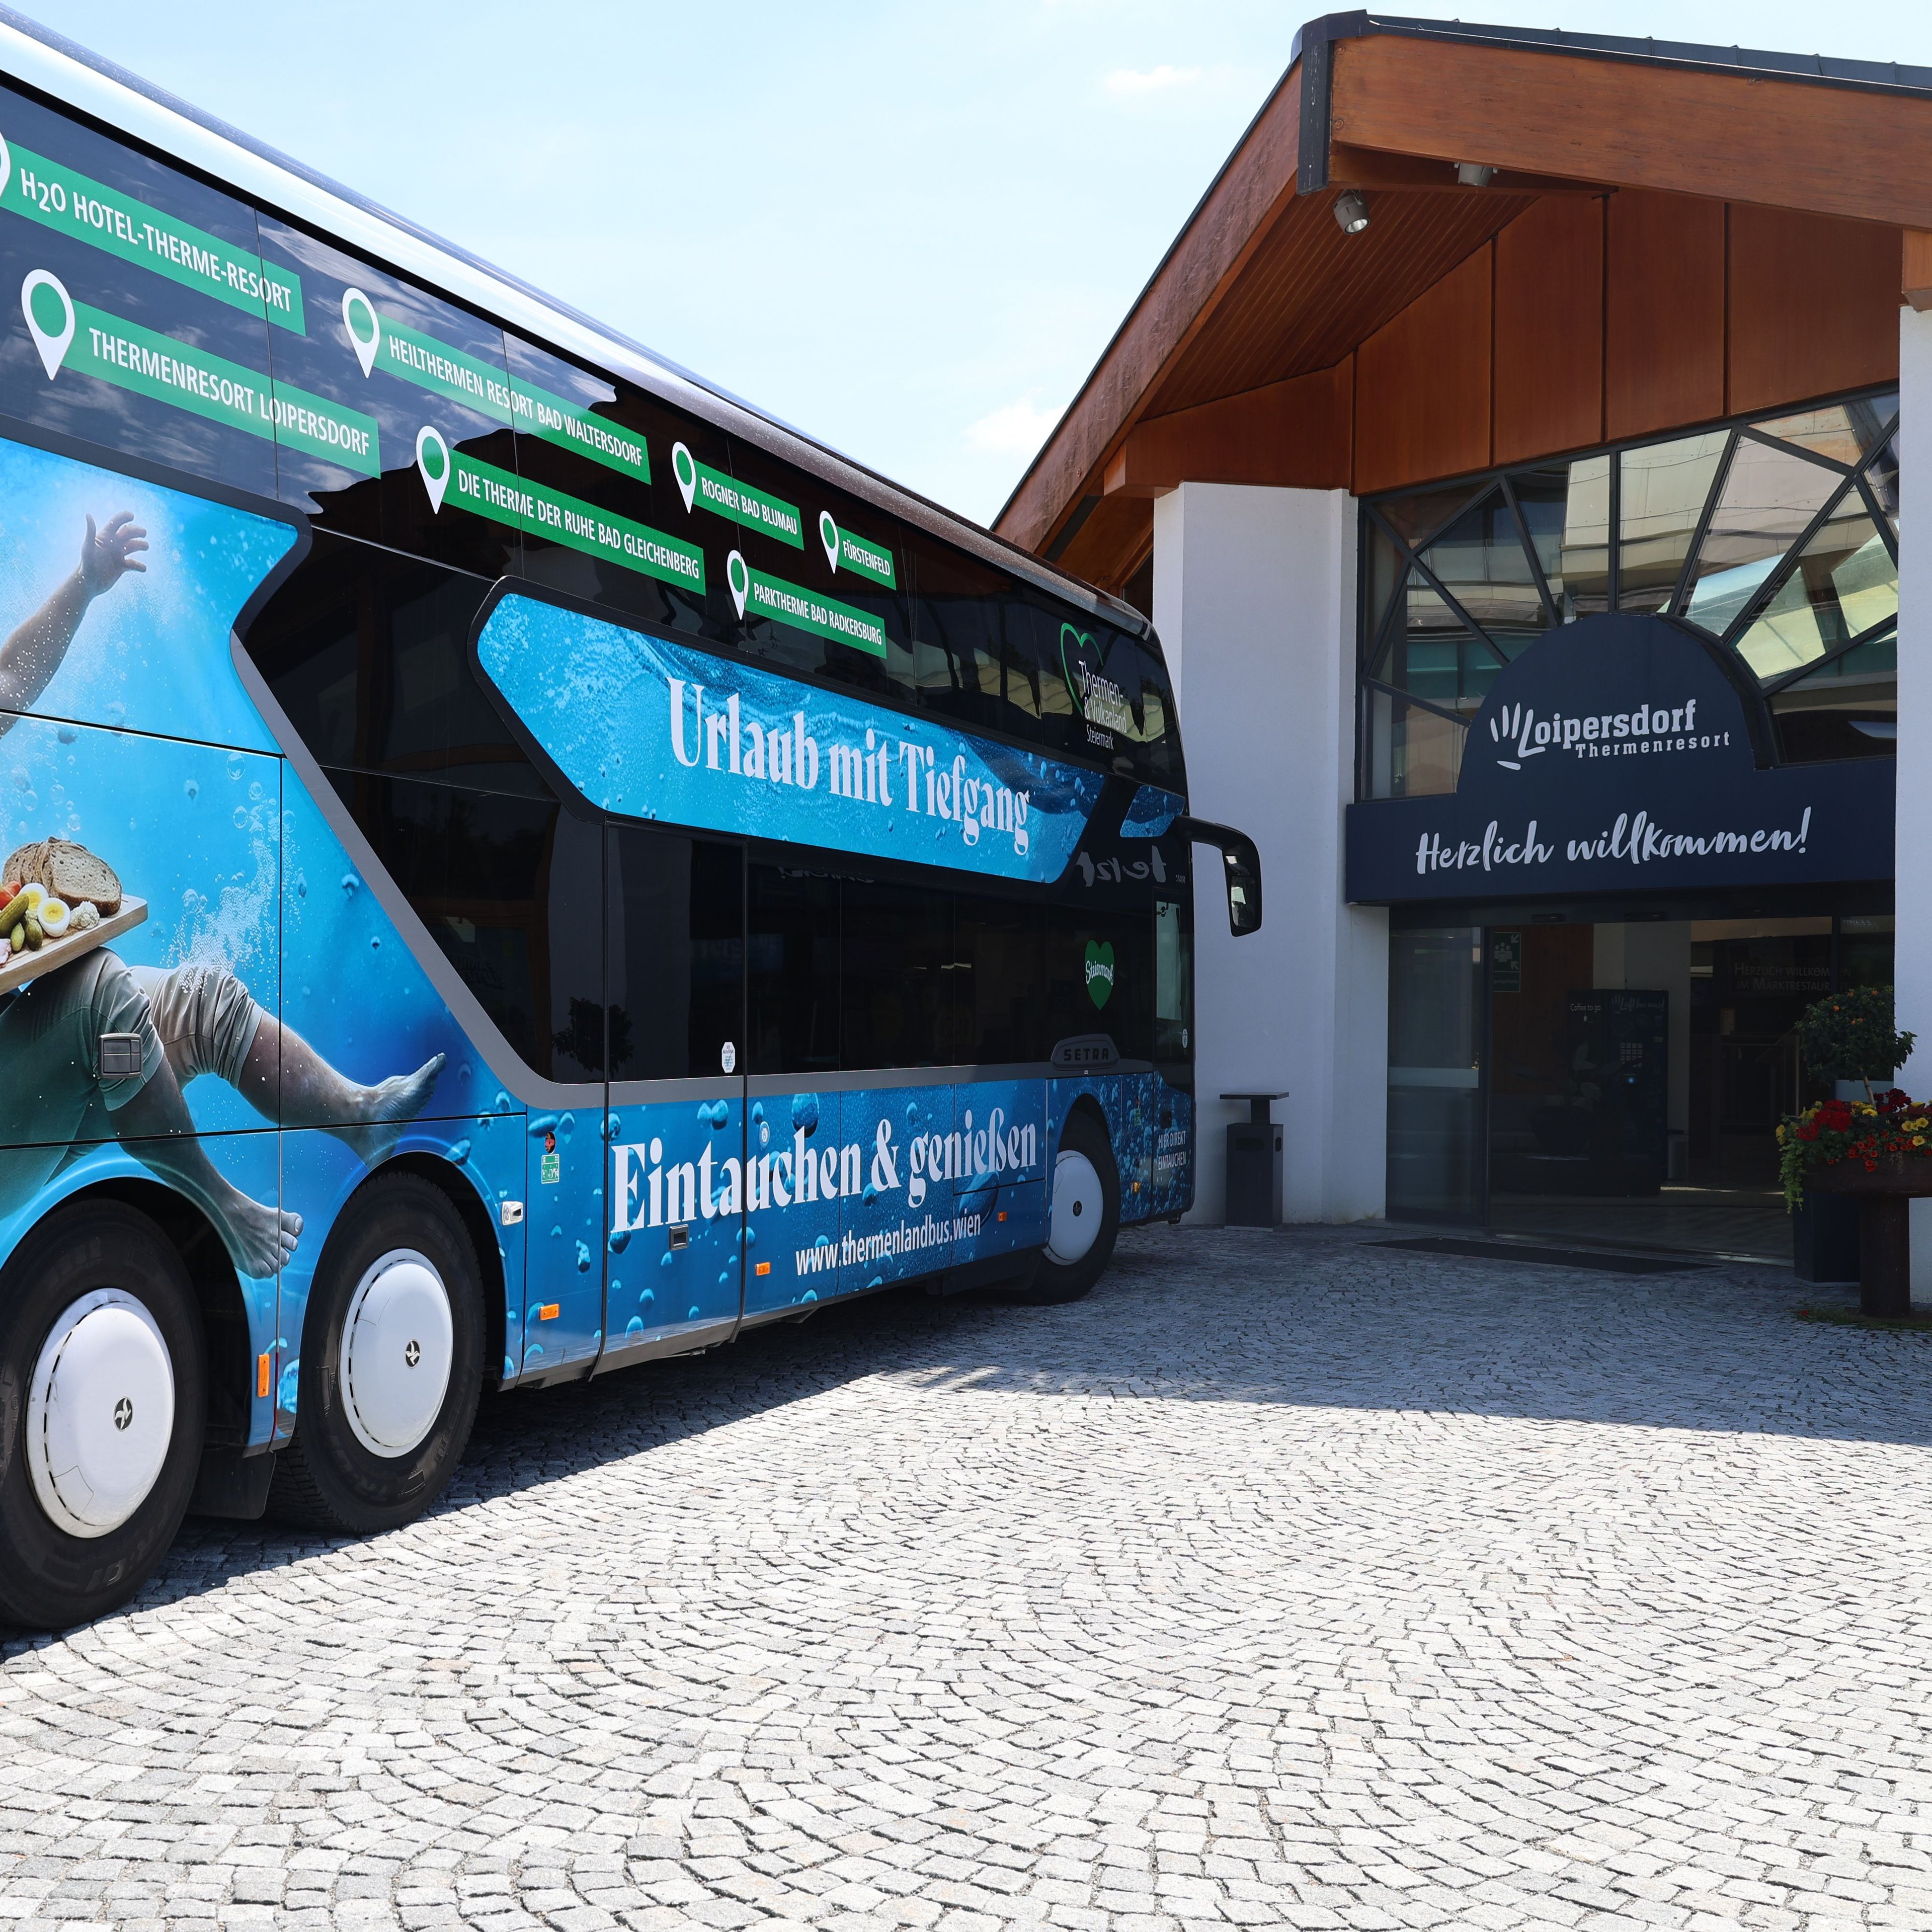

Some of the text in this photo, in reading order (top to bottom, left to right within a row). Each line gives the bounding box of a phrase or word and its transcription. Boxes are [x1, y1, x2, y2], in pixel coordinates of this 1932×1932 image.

[21, 168, 291, 313] H2O HOTEL-THERME-RESORT
[89, 327, 370, 456] THERMENRESORT LOIPERSDORF
[389, 335, 642, 467] HEILTHERMEN RESORT BAD WALTERSDORF
[458, 469, 699, 580] DIE THERME DER RUHE BAD GLEICHENBERG
[701, 476, 797, 535] ROGNER BAD BLUMAU
[843, 538, 891, 577] FÜRSTENFELD
[754, 583, 882, 646] PARKTHERME BAD RADKERSBURG
[1078, 660, 1124, 707] Thermen-
[1084, 696, 1127, 733] & Vulkanland
[1086, 723, 1114, 751] Steiermark
[1518, 699, 1697, 758] Loipersdorf
[666, 677, 1030, 856] Urlaub mit Tiefgang
[1575, 731, 1730, 759] Thermenresort
[1416, 806, 1812, 874] Herzlich willkommen!
[1085, 960, 1114, 986] Steiermark
[1570, 1003, 1586, 1012] Coffee
[1064, 1048, 1108, 1061] SETRA
[1158, 1130, 1186, 1149] HIER DIREKT
[1158, 1151, 1187, 1171] EINTAUCHEN
[610, 1107, 1037, 1234] Eintauchen & genießen
[795, 1209, 981, 1276] www.thermenlandbus.wien
